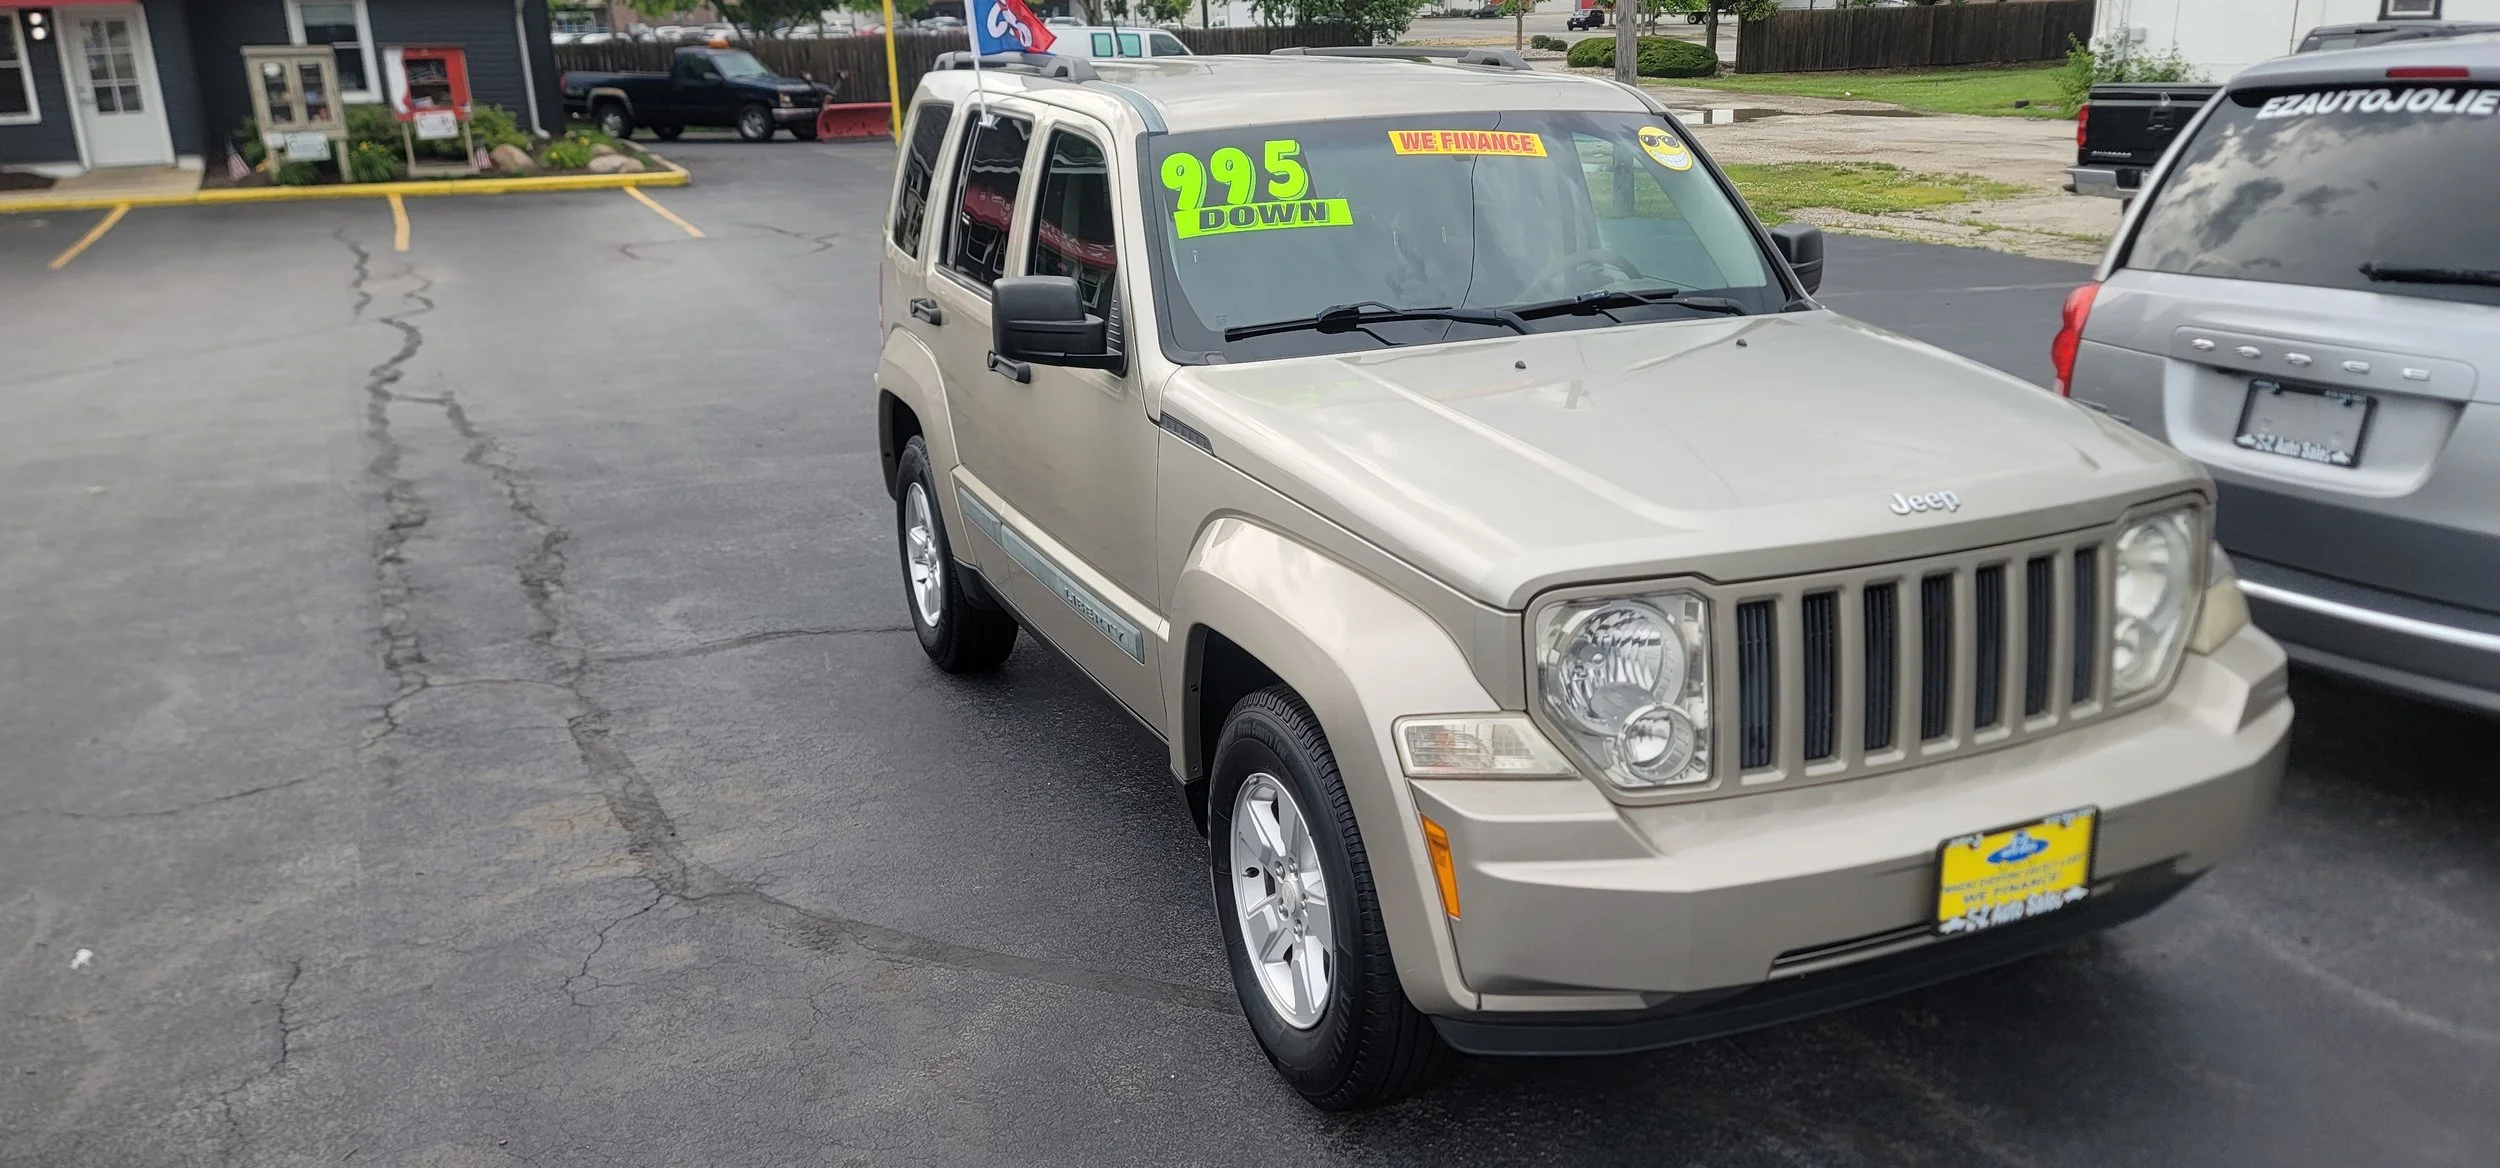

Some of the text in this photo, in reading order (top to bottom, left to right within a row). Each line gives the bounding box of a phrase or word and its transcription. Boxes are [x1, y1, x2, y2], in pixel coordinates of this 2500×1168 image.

[2256, 88, 2500, 120] EZAUTOJOLIE
[1399, 132, 1537, 153] WE FINANCE
[1160, 139, 1309, 211] 995
[1200, 202, 1331, 232] DOWN
[1889, 490, 1961, 515] Jeep
[1064, 587, 1124, 643] LIBERTY
